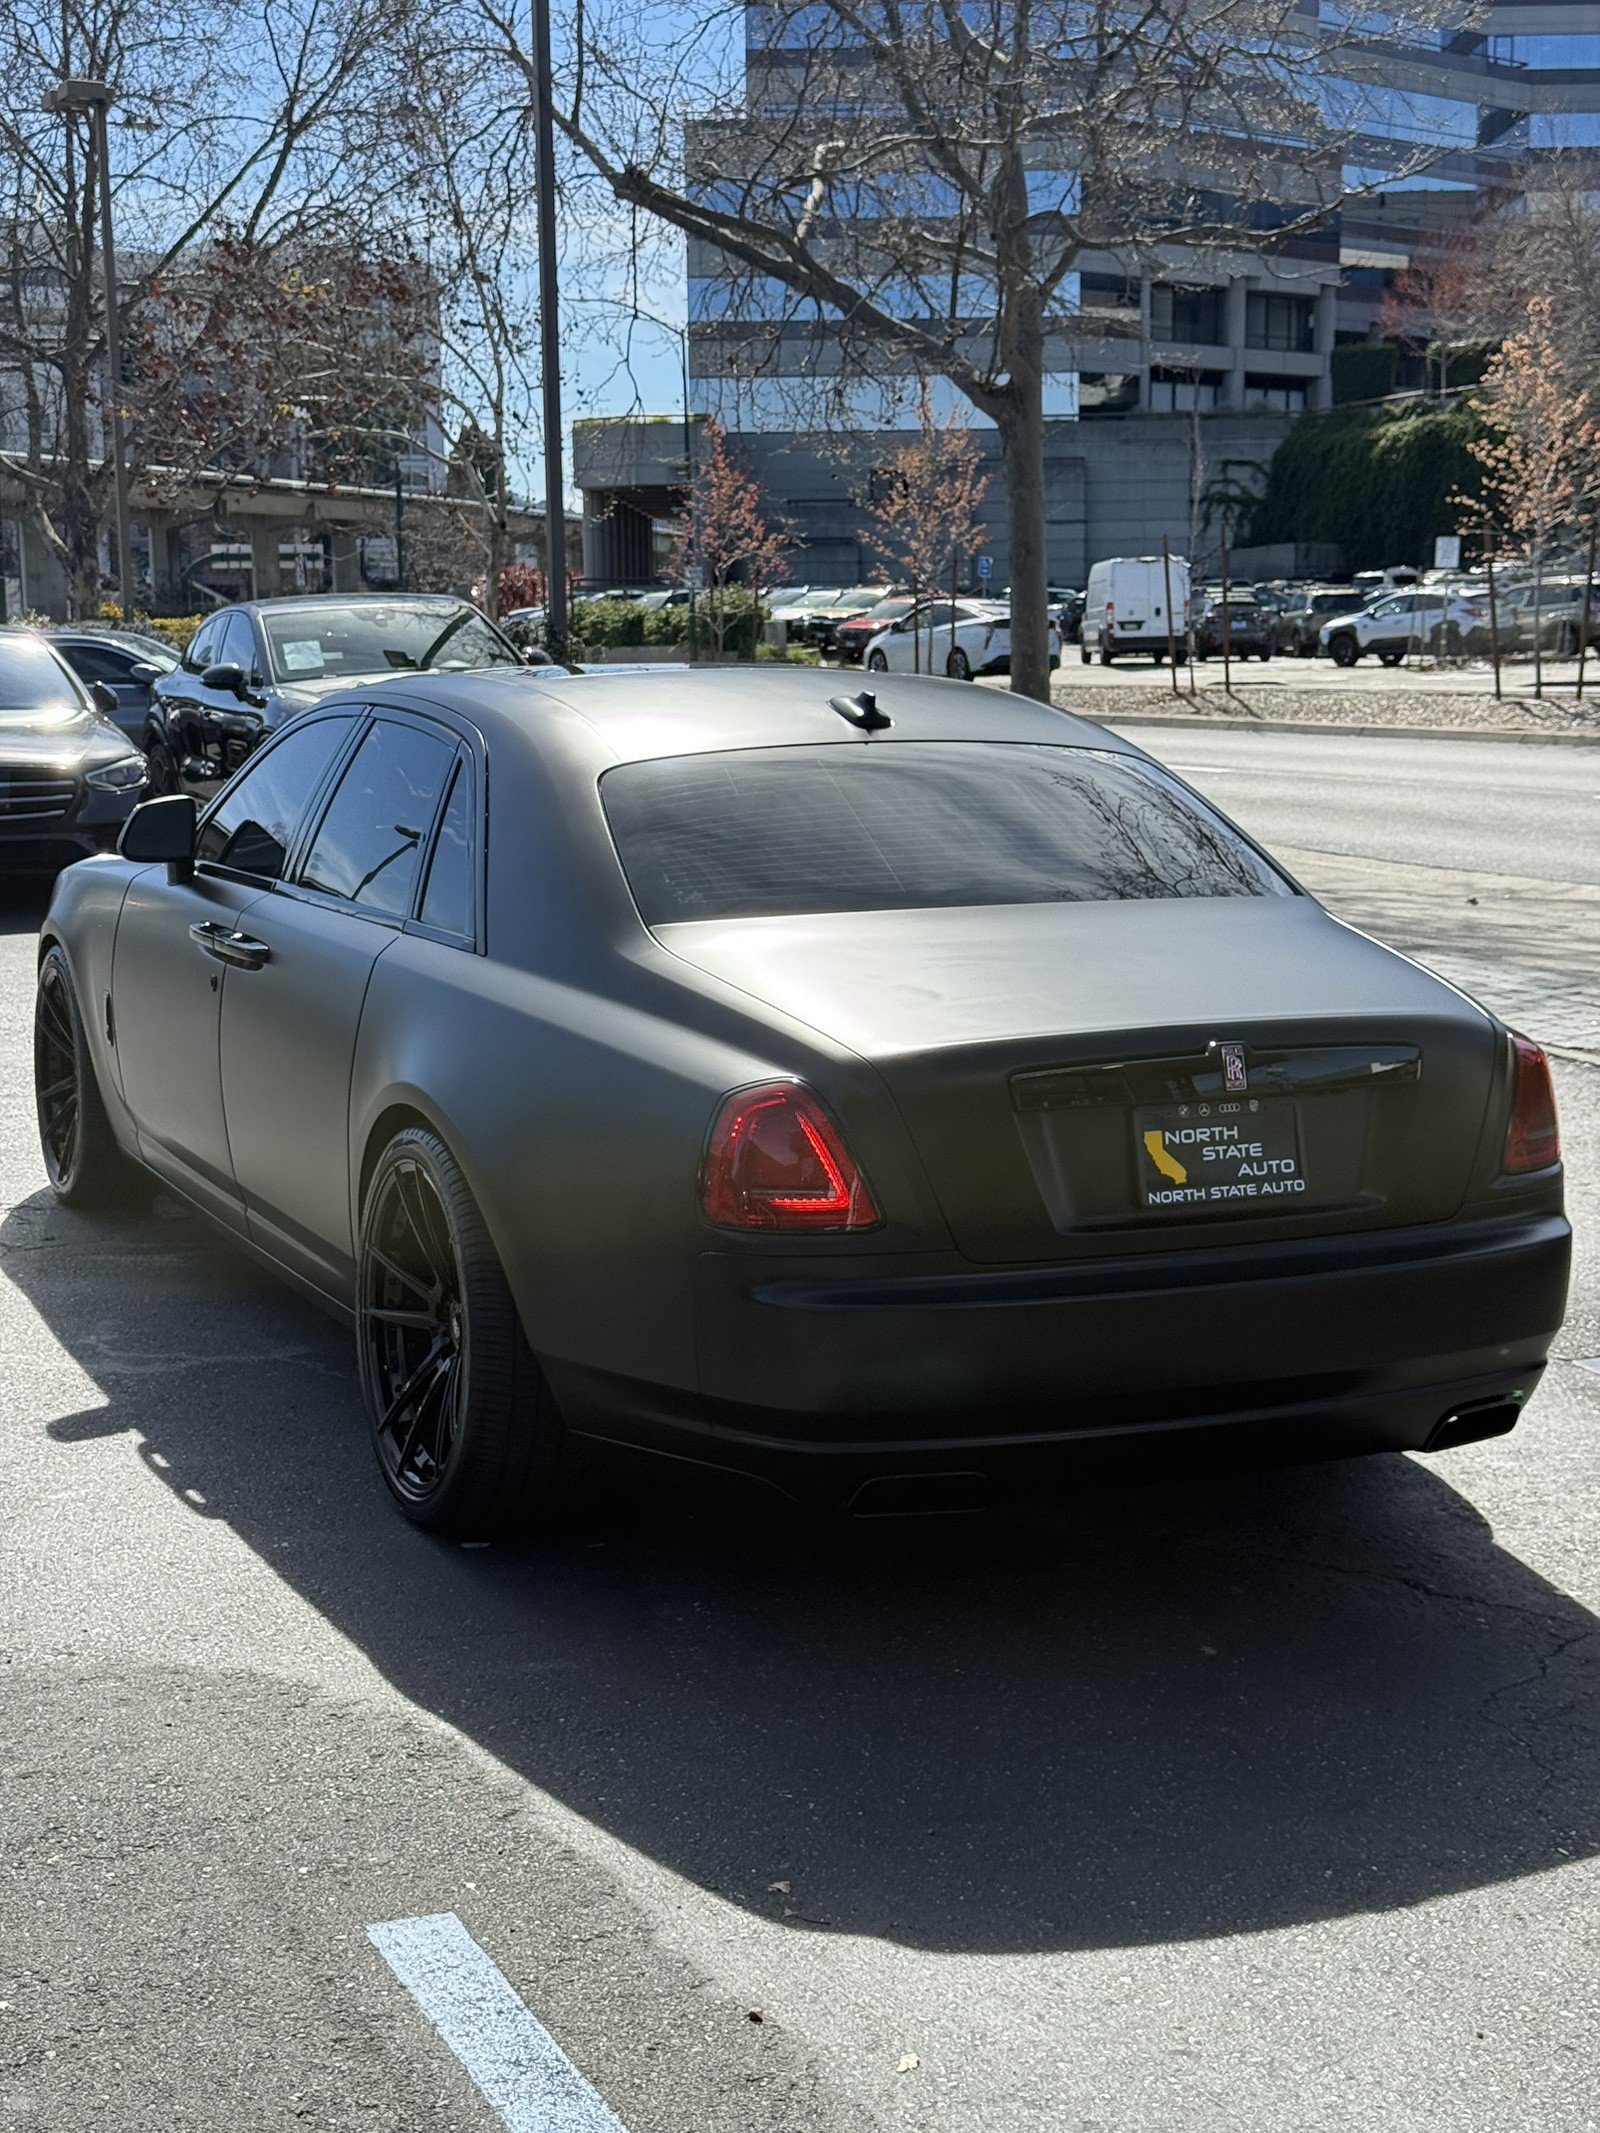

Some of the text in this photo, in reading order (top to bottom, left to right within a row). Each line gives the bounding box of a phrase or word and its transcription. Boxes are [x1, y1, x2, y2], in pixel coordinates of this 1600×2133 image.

[1165, 1126, 1238, 1145] NORTH
[1202, 1143, 1263, 1161] STATE
[1238, 1159, 1295, 1177] AUTO
[1148, 1179, 1305, 1205] NORTH STATE AUTO
